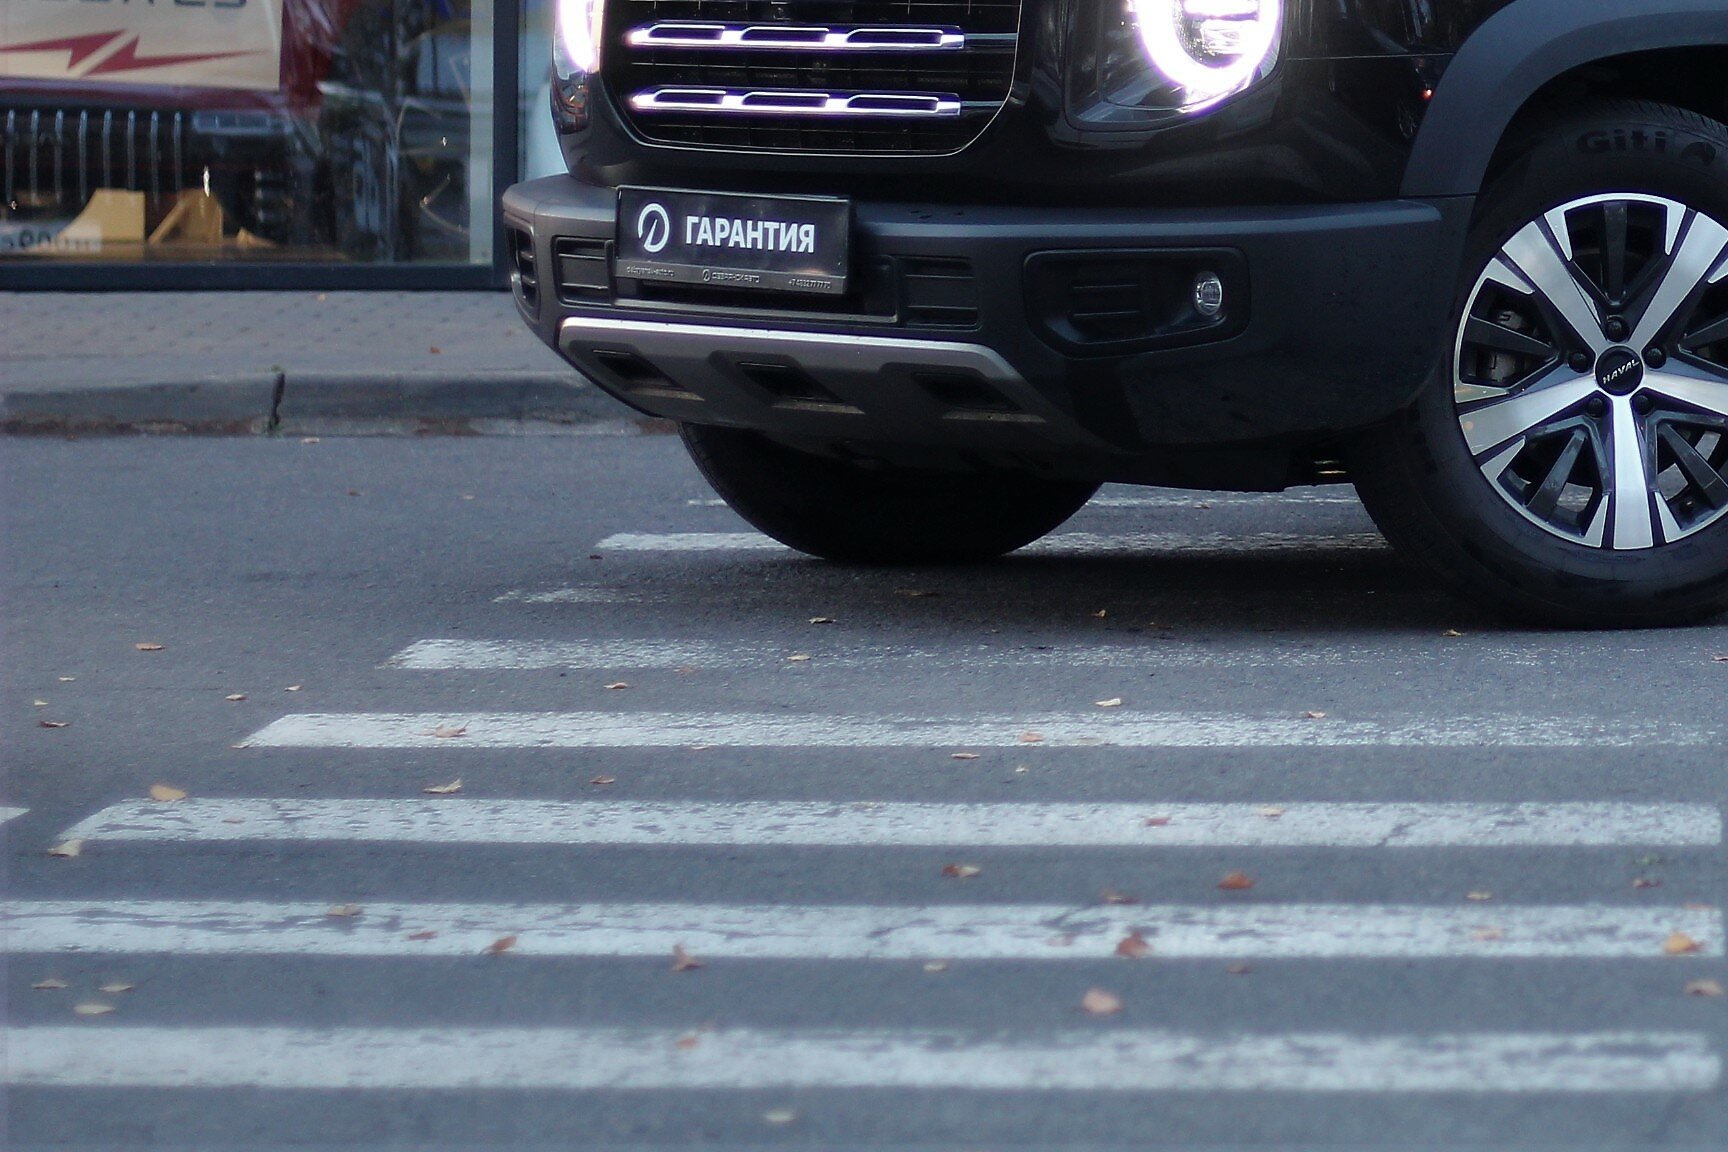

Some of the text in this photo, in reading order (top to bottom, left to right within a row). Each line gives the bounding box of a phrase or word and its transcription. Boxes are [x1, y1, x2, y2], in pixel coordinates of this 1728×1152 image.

[1577, 128, 1667, 155] Giti
[685, 214, 815, 254] ГАРАНТИЯ
[1602, 359, 1640, 385] HAVAL
